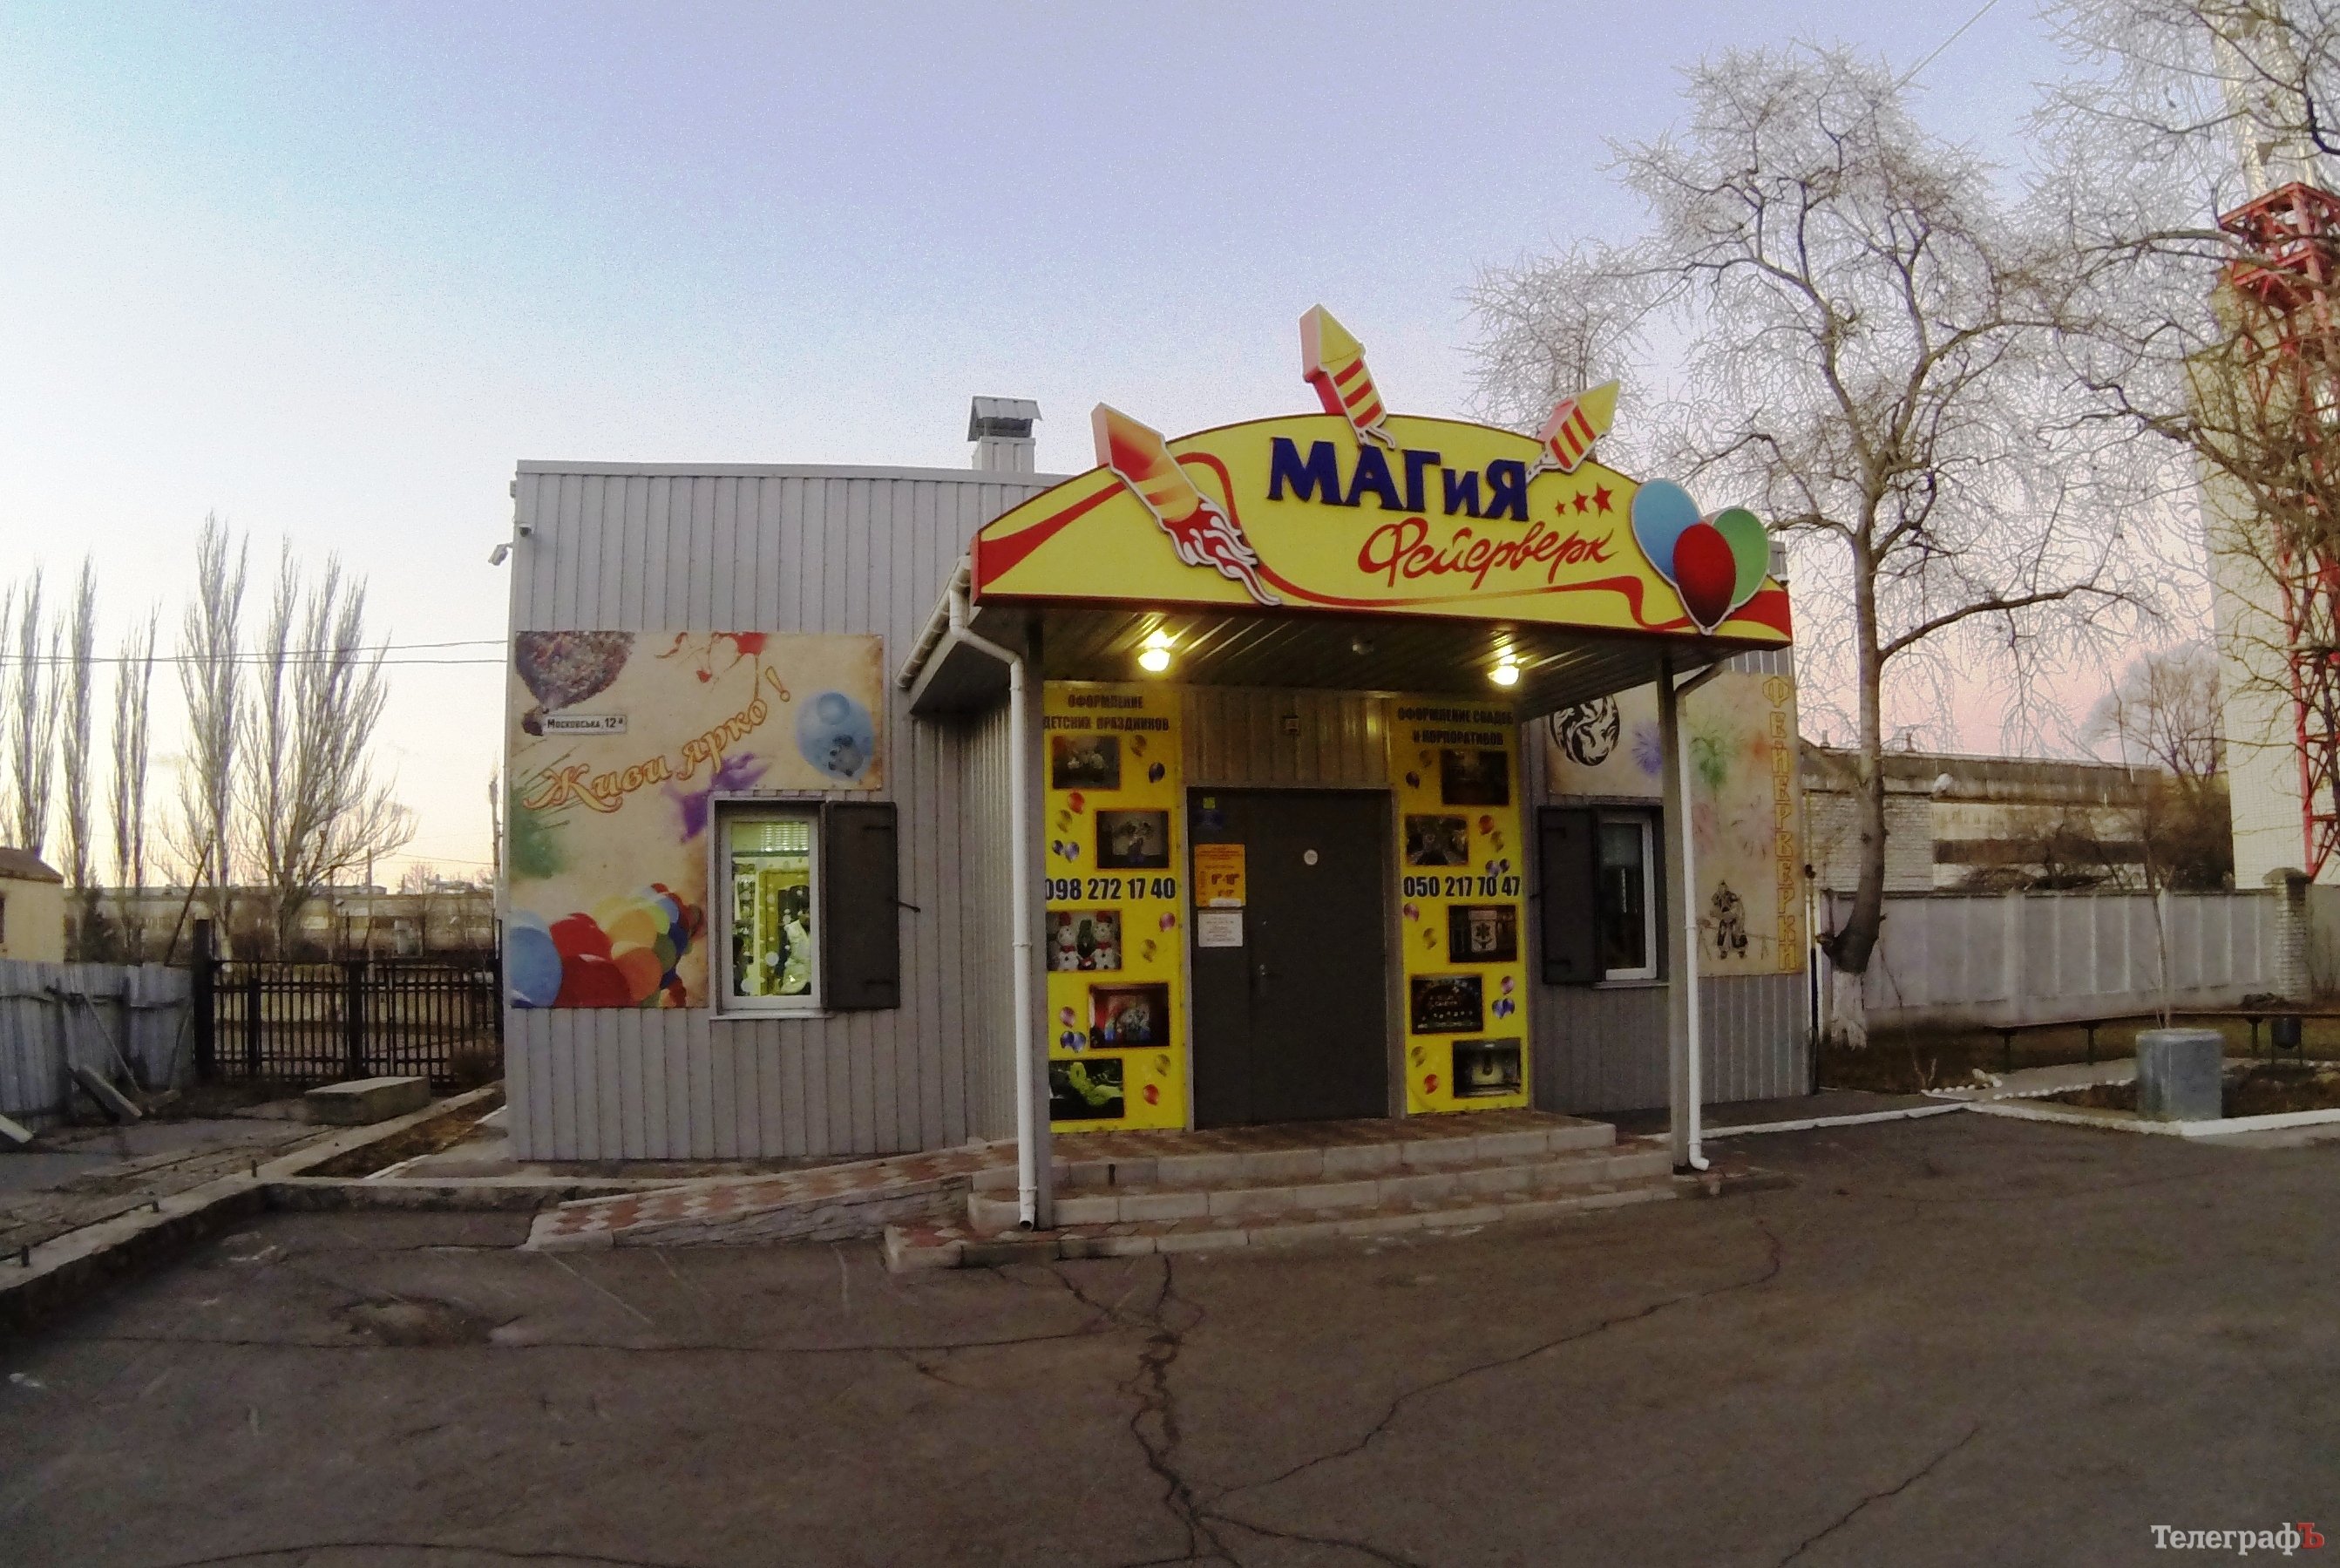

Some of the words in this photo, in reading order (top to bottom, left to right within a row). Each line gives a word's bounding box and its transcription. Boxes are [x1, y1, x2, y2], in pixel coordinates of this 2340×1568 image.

[1357, 516, 1620, 591] Фейерверк
[524, 756, 674, 813] Живи
[1046, 878, 1082, 900] 098
[1087, 878, 1122, 900] 272
[1127, 877, 1147, 899] 17
[1150, 877, 1176, 899] 40
[1403, 875, 1440, 897] 050
[1445, 875, 1472, 897] 217
[1477, 875, 1497, 897] 70
[1501, 875, 1520, 897] 47
